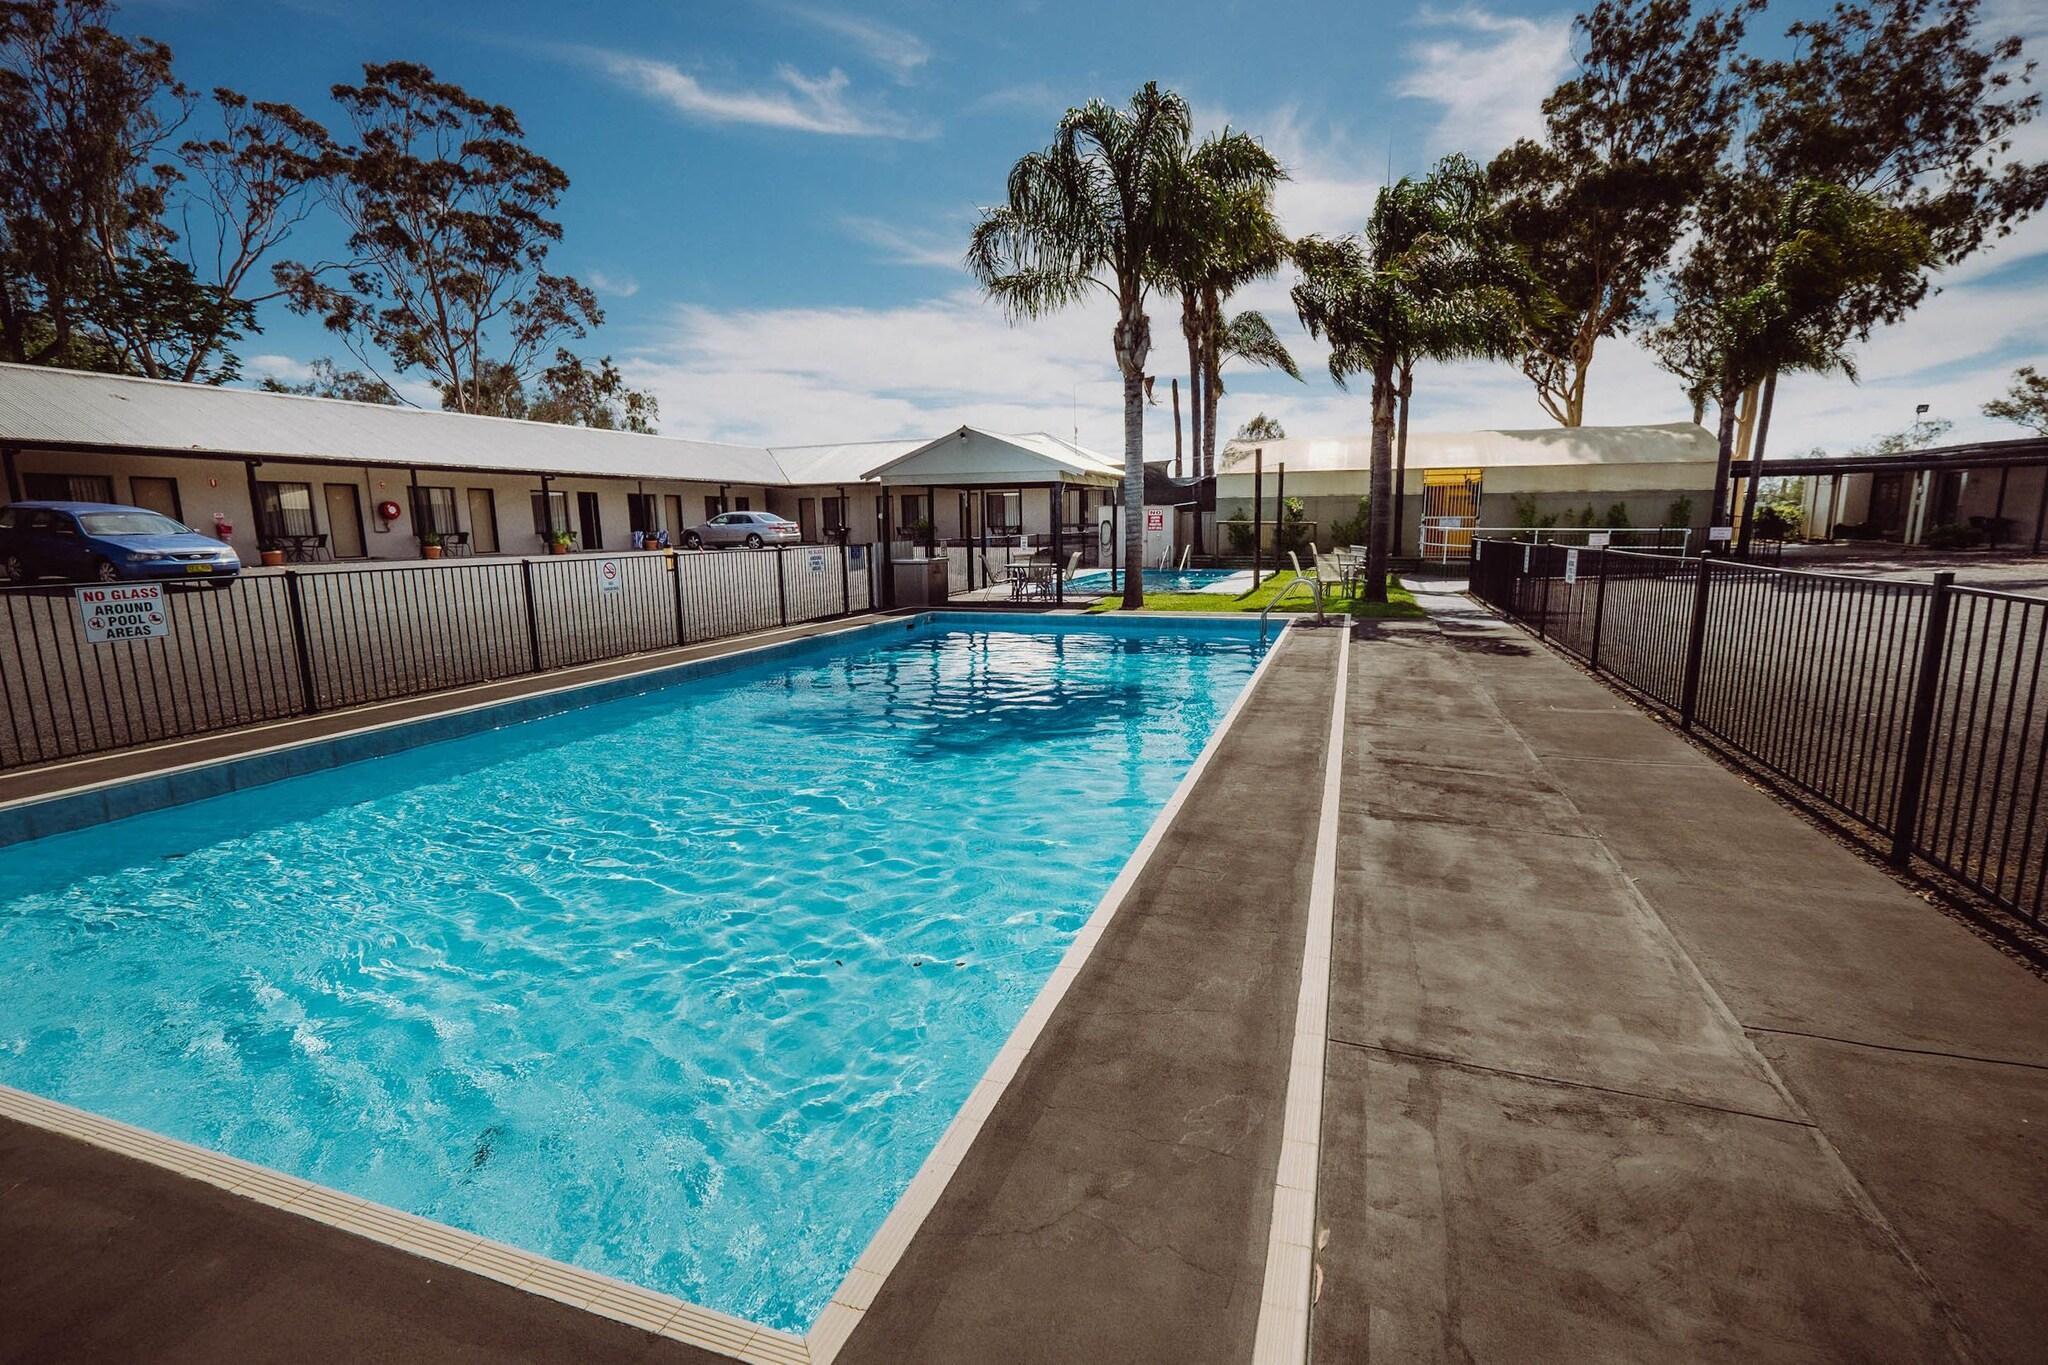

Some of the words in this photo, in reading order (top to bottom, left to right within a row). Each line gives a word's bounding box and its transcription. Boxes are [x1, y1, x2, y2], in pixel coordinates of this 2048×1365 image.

[83, 591, 105, 602] NO
[111, 587, 158, 600] GLASS
[95, 602, 153, 615] AROUND
[108, 614, 145, 626] POOL
[106, 625, 151, 639] AREAS
